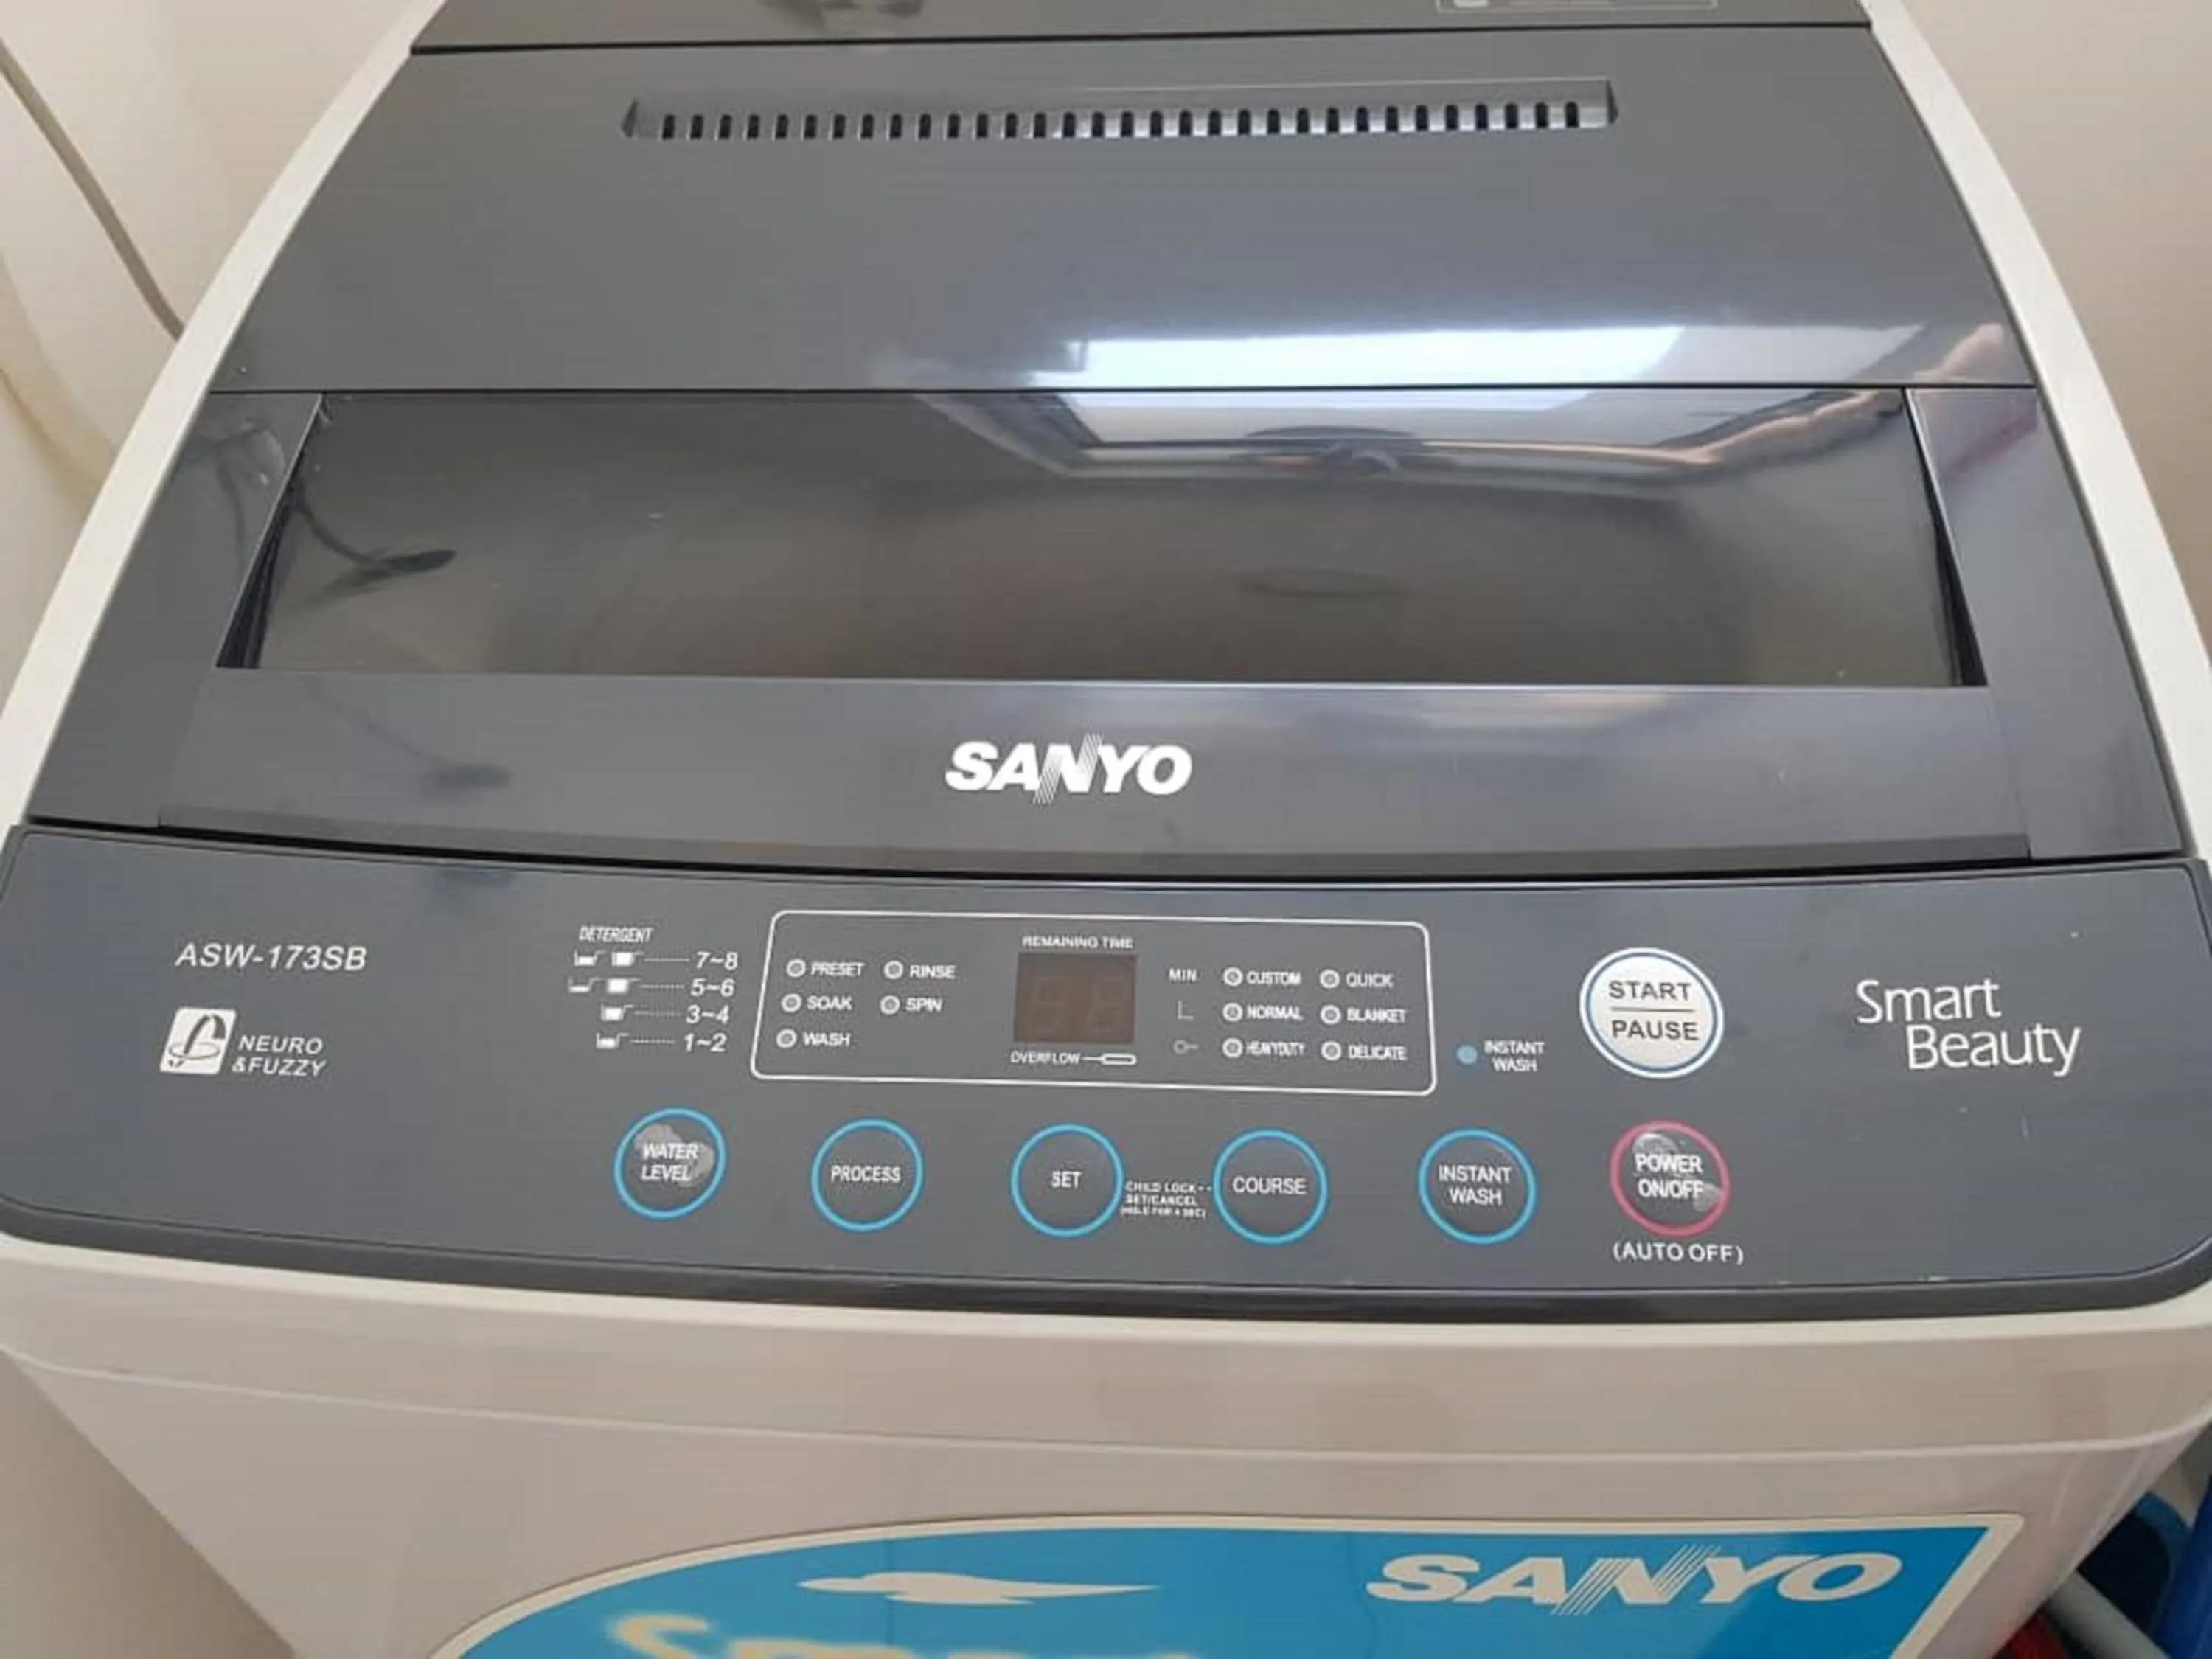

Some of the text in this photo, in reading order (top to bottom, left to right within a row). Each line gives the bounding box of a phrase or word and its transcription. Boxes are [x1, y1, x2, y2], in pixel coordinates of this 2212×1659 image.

[945, 734, 1193, 804] SANYO
[578, 925, 654, 943] DETERGENT
[1022, 935, 1133, 950] REMAINING TIME
[175, 942, 367, 971] ASW-173SB
[810, 961, 865, 977] PRESET
[909, 964, 957, 980] RINSE
[1246, 970, 1301, 987] CUSTOM
[1346, 973, 1394, 988] QUICK
[1608, 980, 1692, 1001] START
[807, 995, 853, 1011] SOAK
[905, 997, 943, 1013] SPIN
[1855, 978, 2002, 1024] Smart
[1246, 1003, 1304, 1021] NORMAL
[1346, 1007, 1407, 1023] BLANKET
[803, 1031, 852, 1047] WASH
[1611, 1019, 1699, 1041] PAUSE
[238, 1034, 324, 1056] NEURO
[1348, 1045, 1408, 1062] DELICATE
[1484, 1040, 1545, 1054] INSTANT
[1905, 1022, 2081, 1077] Beauty
[231, 1057, 327, 1077] &FUZZY
[1010, 1051, 1082, 1065] OVERFLOW
[1492, 1057, 1538, 1072] WASH
[641, 1141, 699, 1161] WATER
[1635, 1152, 1703, 1174] POWER
[641, 1164, 693, 1181] LEVEL
[830, 1164, 901, 1183] PROCESS
[1051, 1171, 1082, 1189] SET
[1439, 1165, 1512, 1184] INSTANT
[1124, 1180, 1161, 1193] CHILD
[1232, 1175, 1307, 1195] COURSE
[1638, 1178, 1704, 1200] ON/OFF
[1449, 1188, 1503, 1206] WASH
[1613, 1241, 1745, 1265] (AUTO OFF)
[1366, 1543, 1902, 1616] SANYO
